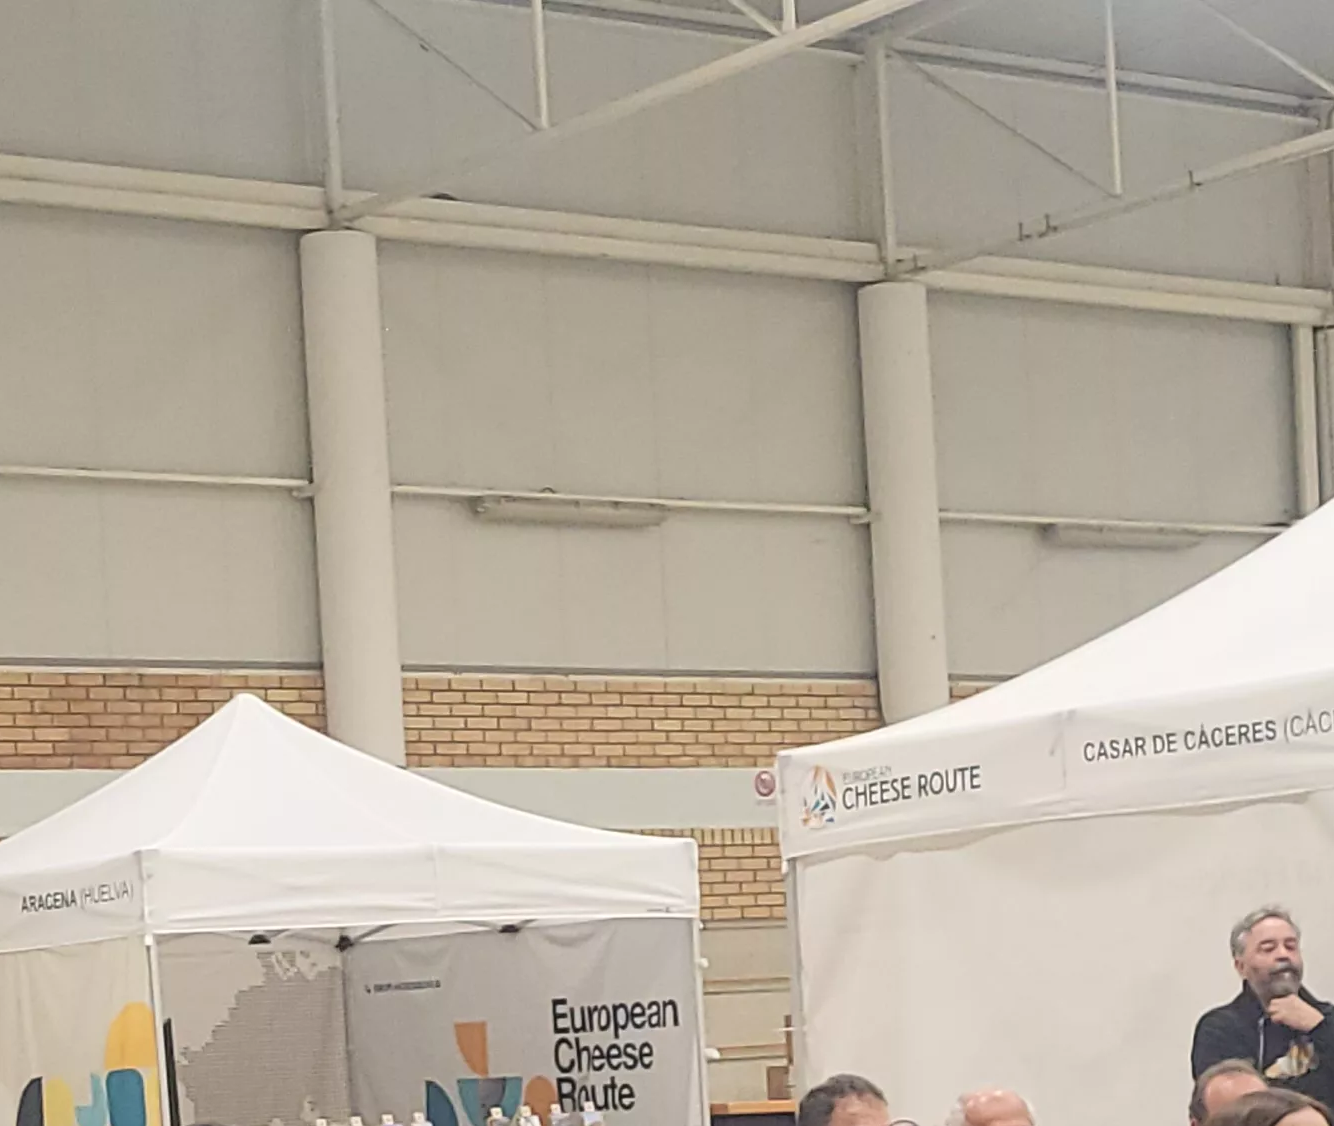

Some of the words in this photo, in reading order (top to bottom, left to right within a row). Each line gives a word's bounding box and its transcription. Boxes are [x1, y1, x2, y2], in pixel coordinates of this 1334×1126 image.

[1083, 736, 1147, 762] CASAR
[1152, 732, 1178, 755] DE
[842, 776, 912, 811] CHEESE
[917, 765, 982, 798] ROUTE
[21, 889, 78, 913] ARACENA
[551, 997, 680, 1040] European
[553, 1036, 655, 1074] Cheese
[555, 1075, 636, 1114] Route
